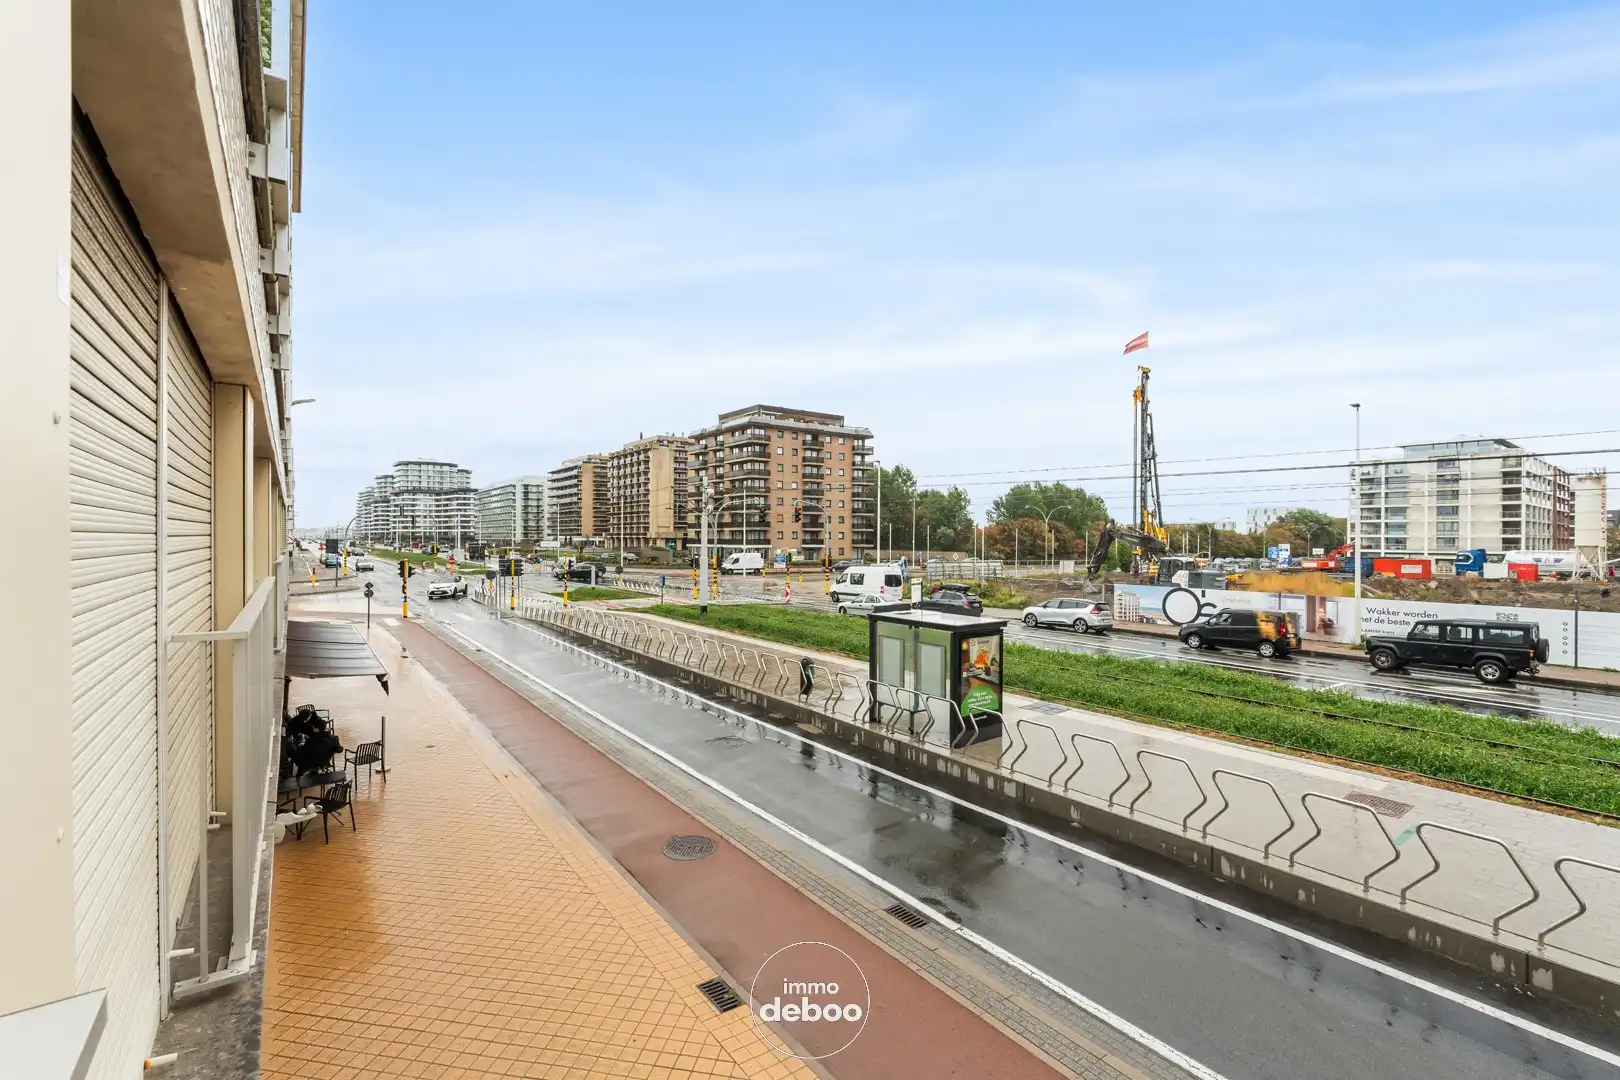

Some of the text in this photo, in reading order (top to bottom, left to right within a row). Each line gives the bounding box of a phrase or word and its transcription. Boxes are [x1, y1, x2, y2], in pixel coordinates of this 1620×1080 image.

[1366, 606, 1438, 619] Wakker worden
[1374, 617, 1385, 625] de
[1387, 618, 1411, 626] beste
